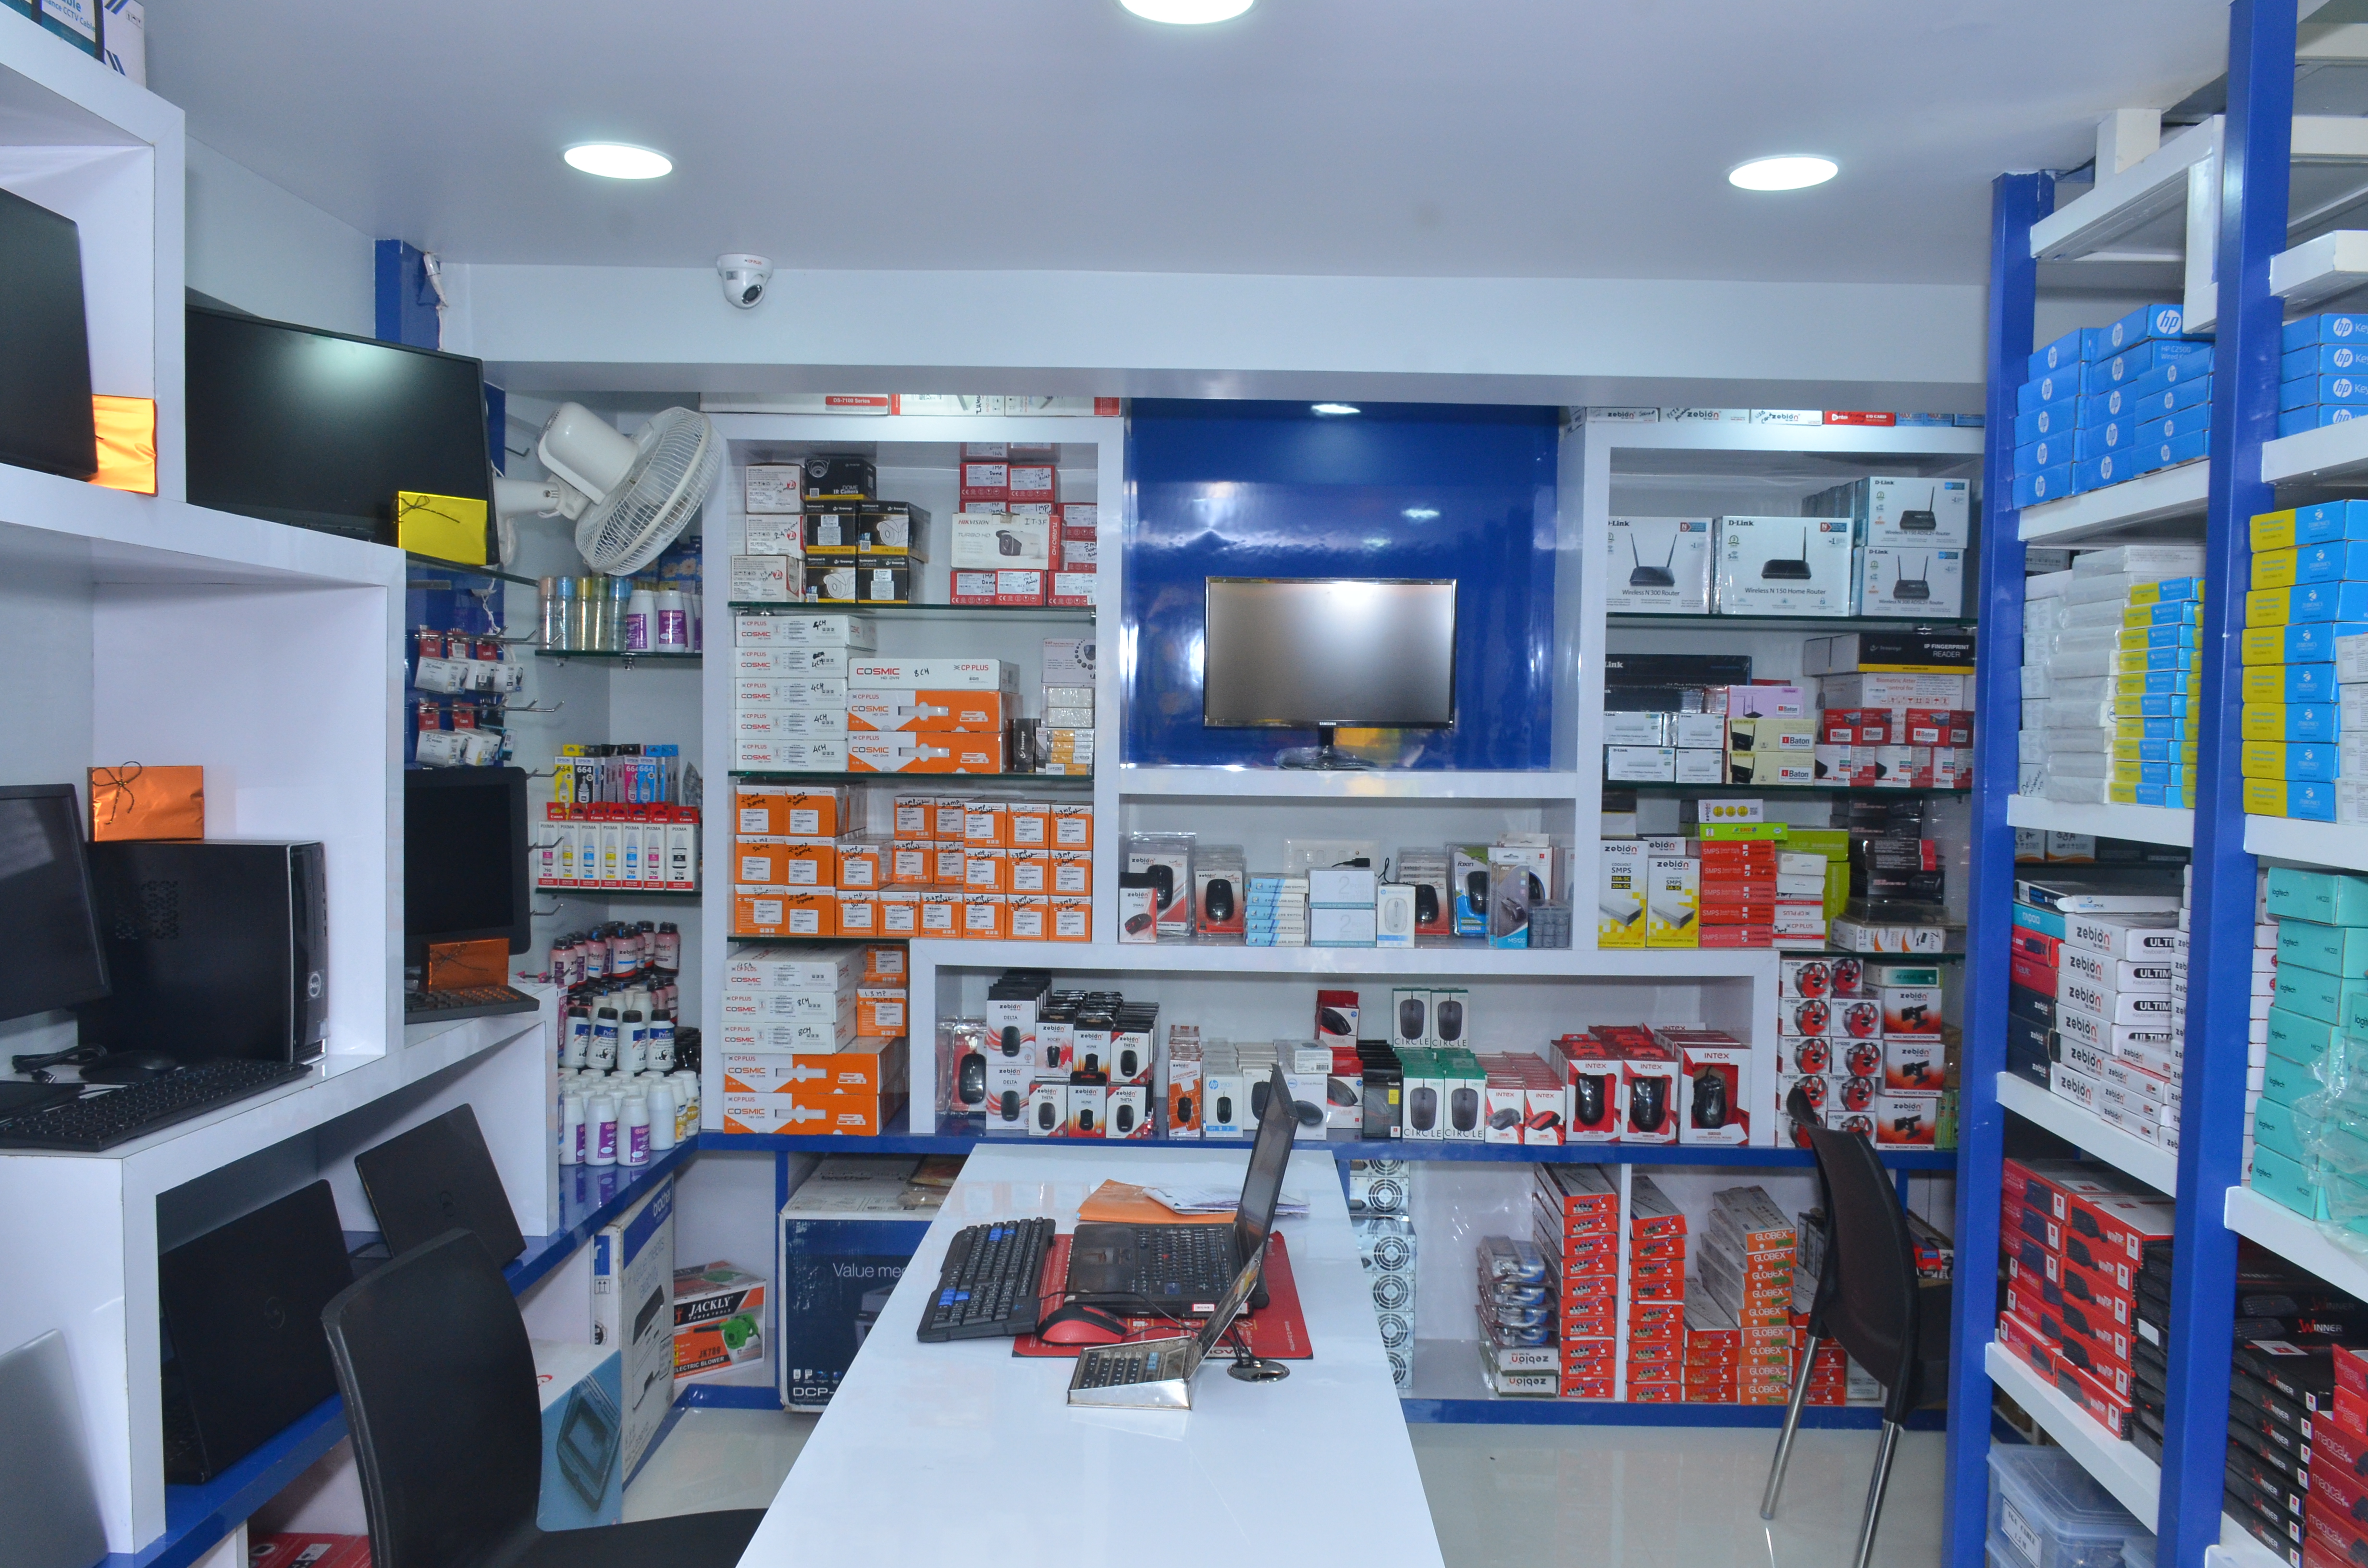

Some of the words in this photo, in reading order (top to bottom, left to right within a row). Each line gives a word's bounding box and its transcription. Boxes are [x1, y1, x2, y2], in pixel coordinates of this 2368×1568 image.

[63, 8, 78, 21] CCTV
[80, 17, 95, 32] Cable
[2159, 311, 2178, 333] hp
[2335, 318, 2350, 336] hp
[1052, 546, 1056, 555] HD
[2272, 888, 2289, 897] logitech
[2077, 926, 2109, 945] zebion
[2282, 937, 2299, 947] logitech
[2070, 956, 2101, 975] zebion
[2140, 969, 2171, 978] ULTIM
[2280, 984, 2296, 994] logitech
[2069, 986, 2101, 1007] zebion
[2140, 1002, 2171, 1010] ULTIM
[2066, 1016, 2097, 1037] zebion
[2271, 1029, 2286, 1041] logitech
[1394, 1038, 1429, 1046] CIRCLE
[2269, 1077, 2285, 1089] logitech
[1404, 1129, 1441, 1138] CIRCLE
[1755, 1231, 1788, 1241] GLOBEX
[1754, 1252, 1785, 1262] GLOBEX
[833, 1263, 874, 1277] Value
[1752, 1271, 1784, 1280] GLOBEX
[1752, 1288, 1784, 1298] GLOBEX
[689, 1297, 731, 1317] JACKLY
[674, 1363, 699, 1372] LECTRIC
[701, 1357, 724, 1367] BLOWER
